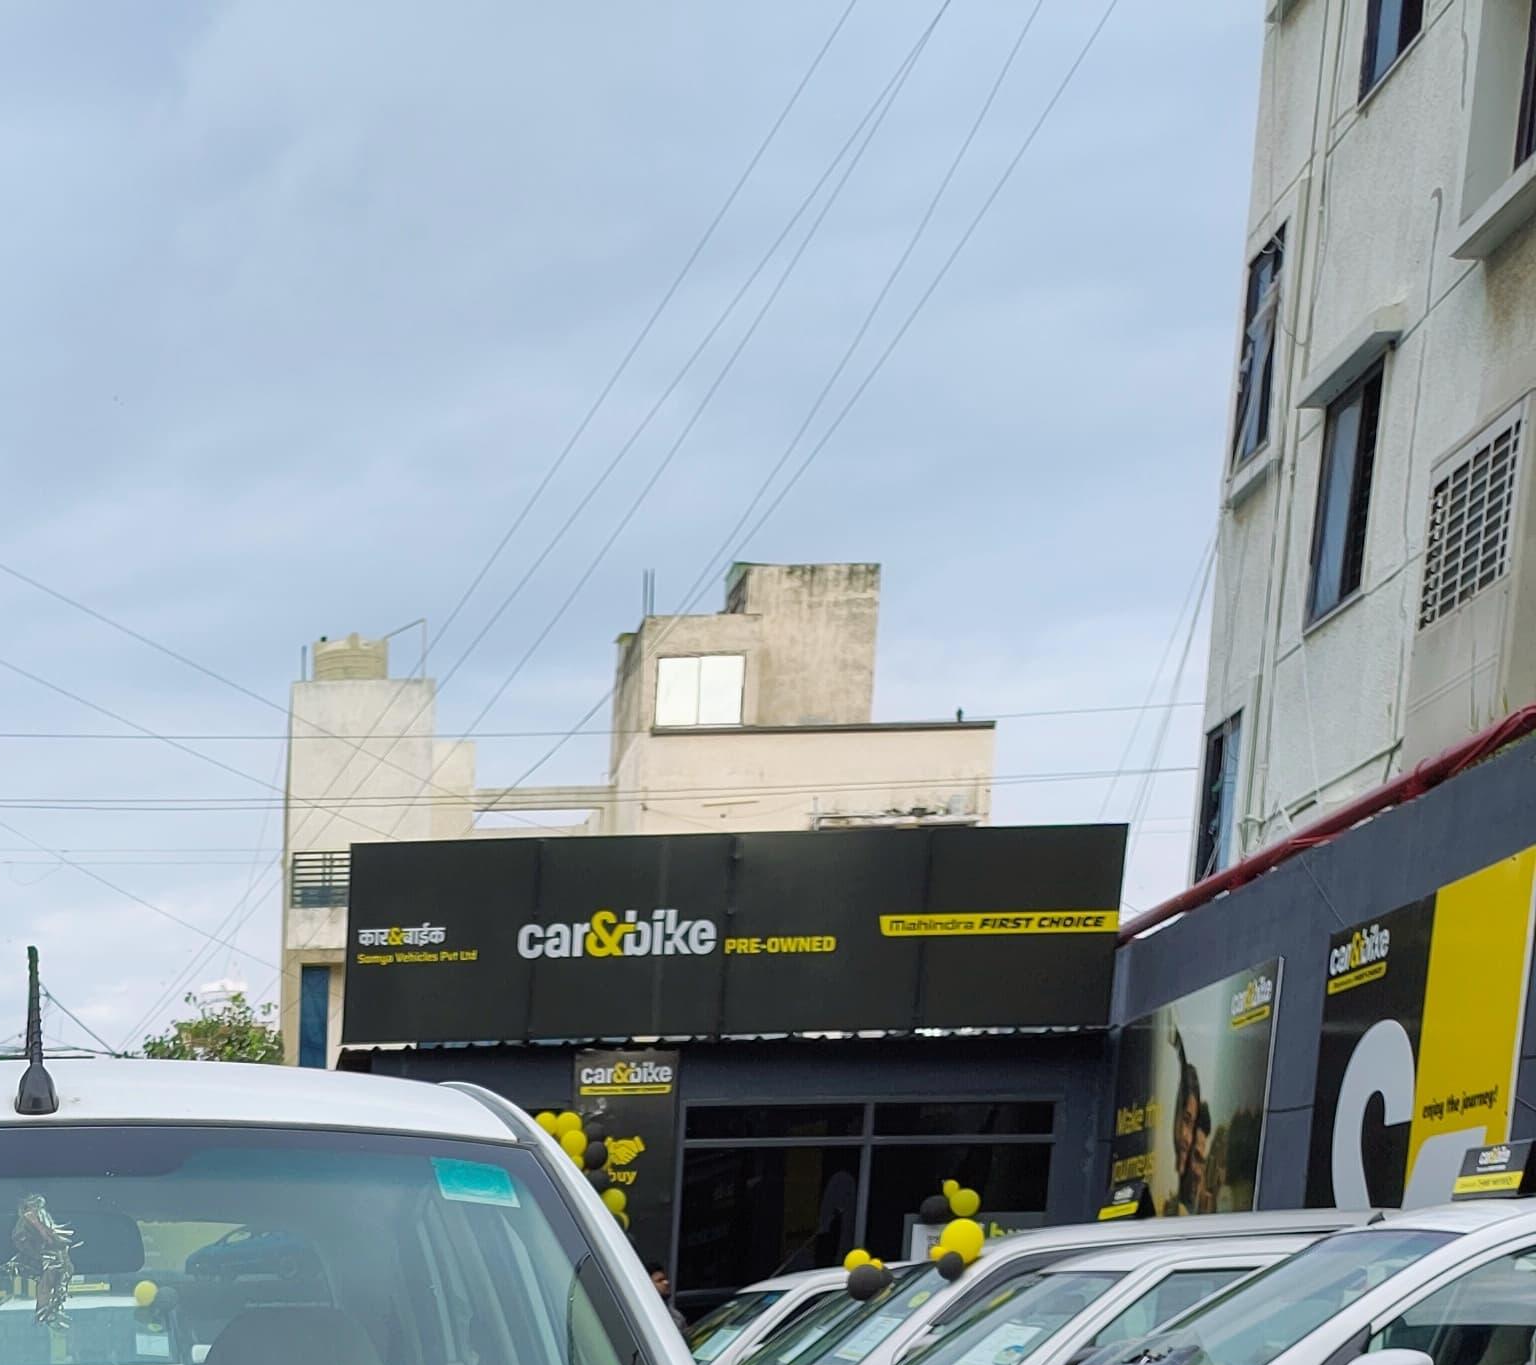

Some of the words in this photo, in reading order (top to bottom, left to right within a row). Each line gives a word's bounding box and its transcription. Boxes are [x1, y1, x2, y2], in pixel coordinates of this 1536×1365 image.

[517, 908, 717, 959] car&bike
[724, 936, 837, 954] PRE-OWNED
[889, 919, 974, 932] Mahindra
[979, 917, 1034, 929] FIRST
[1037, 916, 1105, 928] CHOICE
[460, 950, 478, 961] Ltd
[1329, 924, 1390, 976] car&bike
[580, 1062, 672, 1084] car&bike
